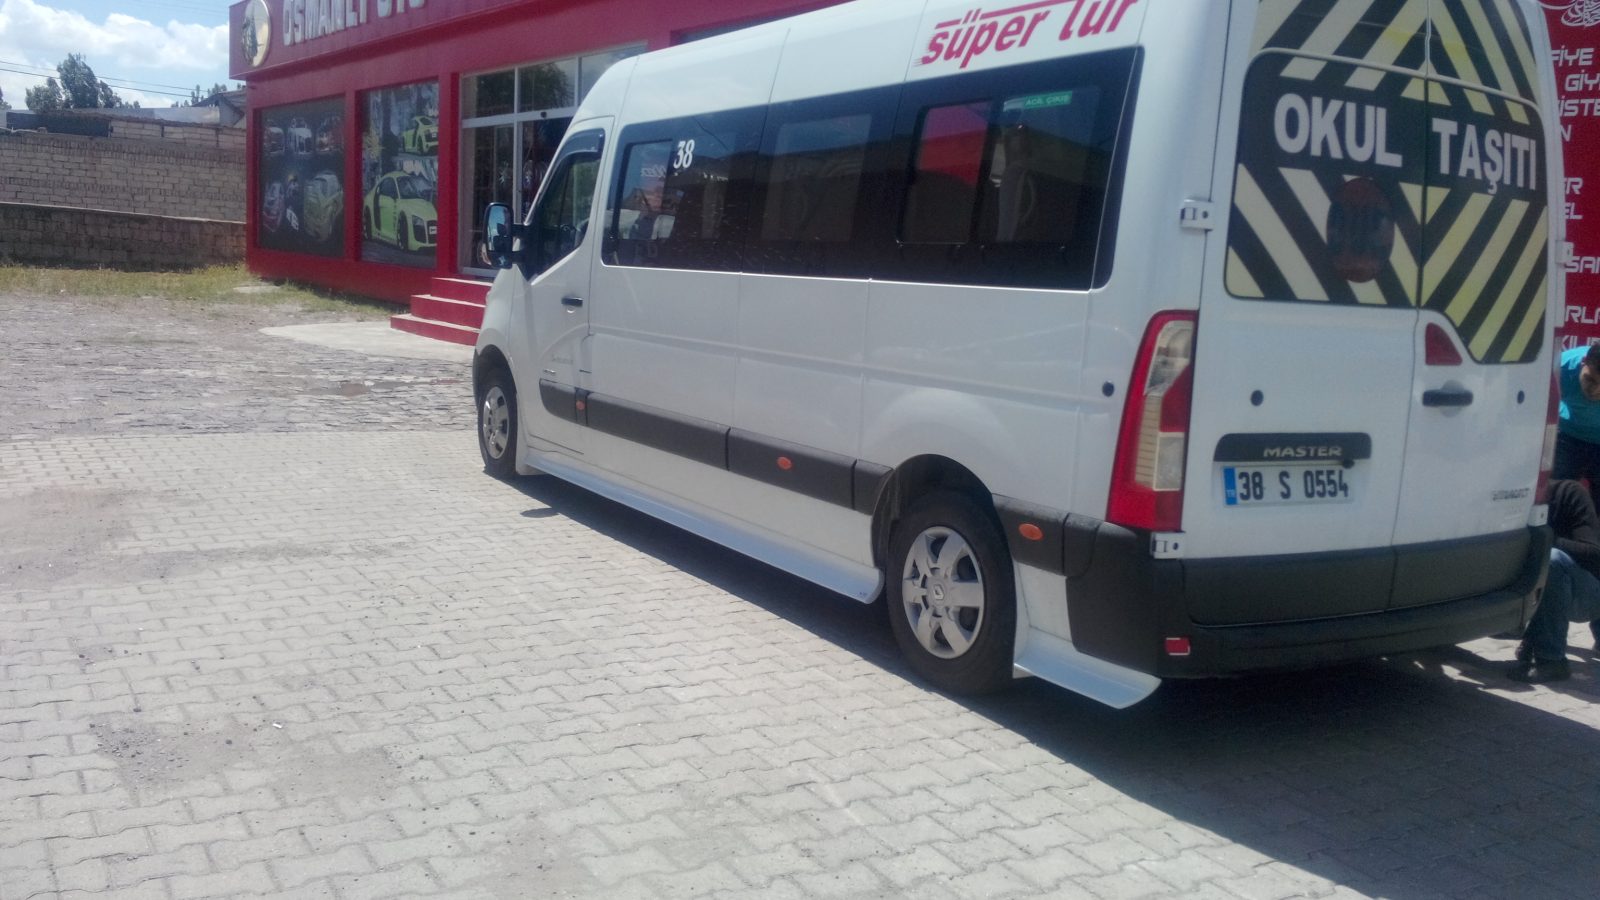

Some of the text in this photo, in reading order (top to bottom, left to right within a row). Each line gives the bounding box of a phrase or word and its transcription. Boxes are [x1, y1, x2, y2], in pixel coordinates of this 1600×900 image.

[917, 8, 1051, 70] süper
[1564, 69, 1600, 92] GİY
[672, 138, 696, 169] 38
[1273, 92, 1537, 194] OKUL TAŞITI
[1565, 255, 1600, 274] SA
[1564, 304, 1600, 325] RL
[1262, 445, 1343, 458] MASTER
[1238, 470, 1265, 501] 38
[1278, 470, 1292, 500] S
[1303, 469, 1349, 499] 0554
